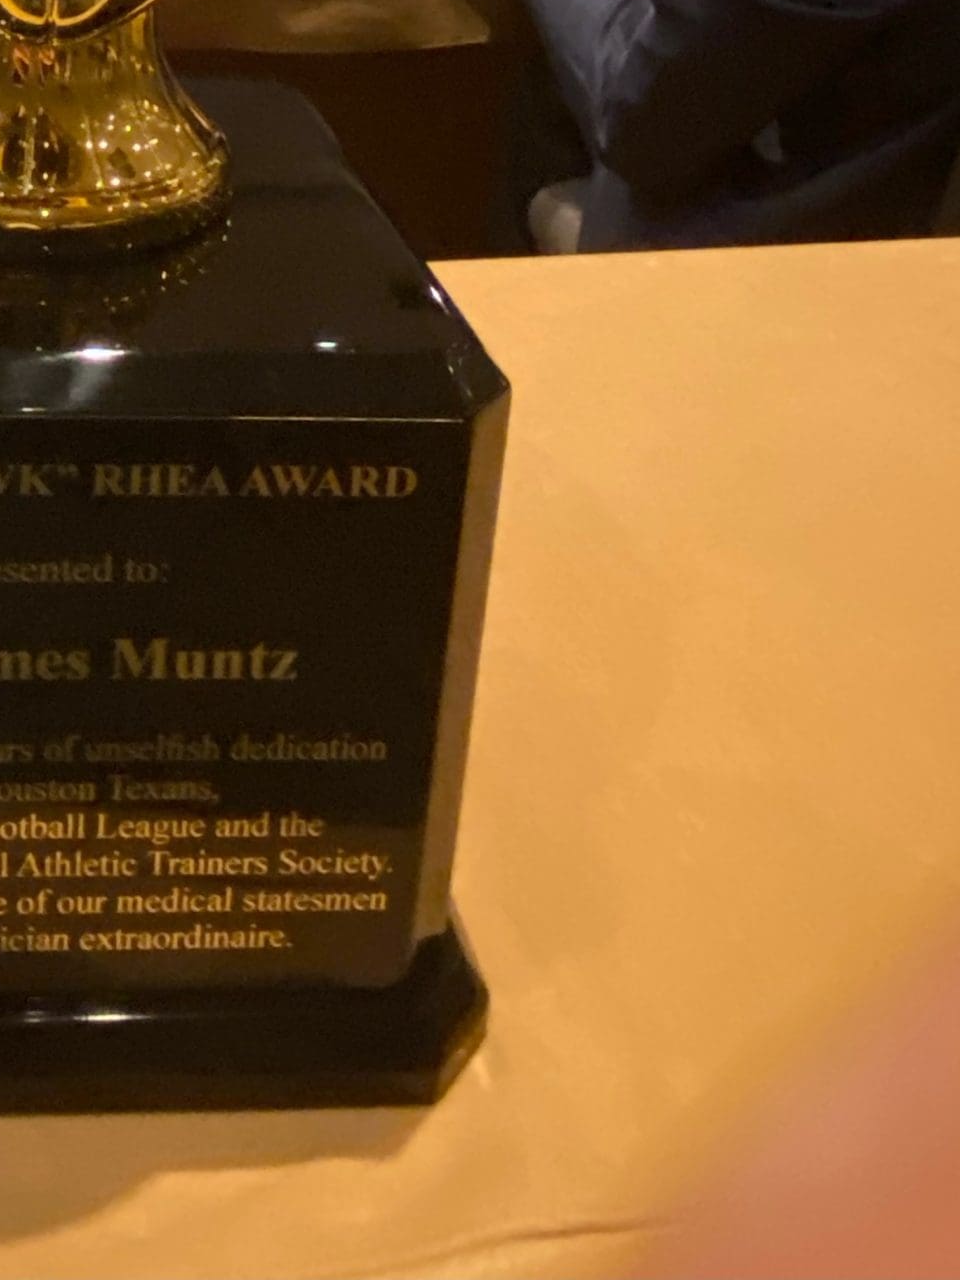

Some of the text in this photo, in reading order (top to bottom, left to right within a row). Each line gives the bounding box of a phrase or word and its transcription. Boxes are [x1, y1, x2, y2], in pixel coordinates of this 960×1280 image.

[93, 464, 230, 497] RHEA
[242, 464, 418, 498] AWARD
[112, 637, 299, 681] Muntz
[41, 733, 82, 763] of
[83, 733, 222, 763] unselfish
[229, 733, 388, 762] dedication
[96, 812, 207, 846] League
[214, 811, 270, 838] and
[279, 811, 324, 838] the
[16, 850, 137, 878] Athletic
[148, 849, 269, 876] Trainers
[279, 848, 393, 881] Society.
[16, 888, 53, 915] of
[56, 895, 108, 915] our
[116, 886, 234, 914] medical
[243, 891, 388, 912] statesmen
[78, 924, 292, 952] extraordinaire.
